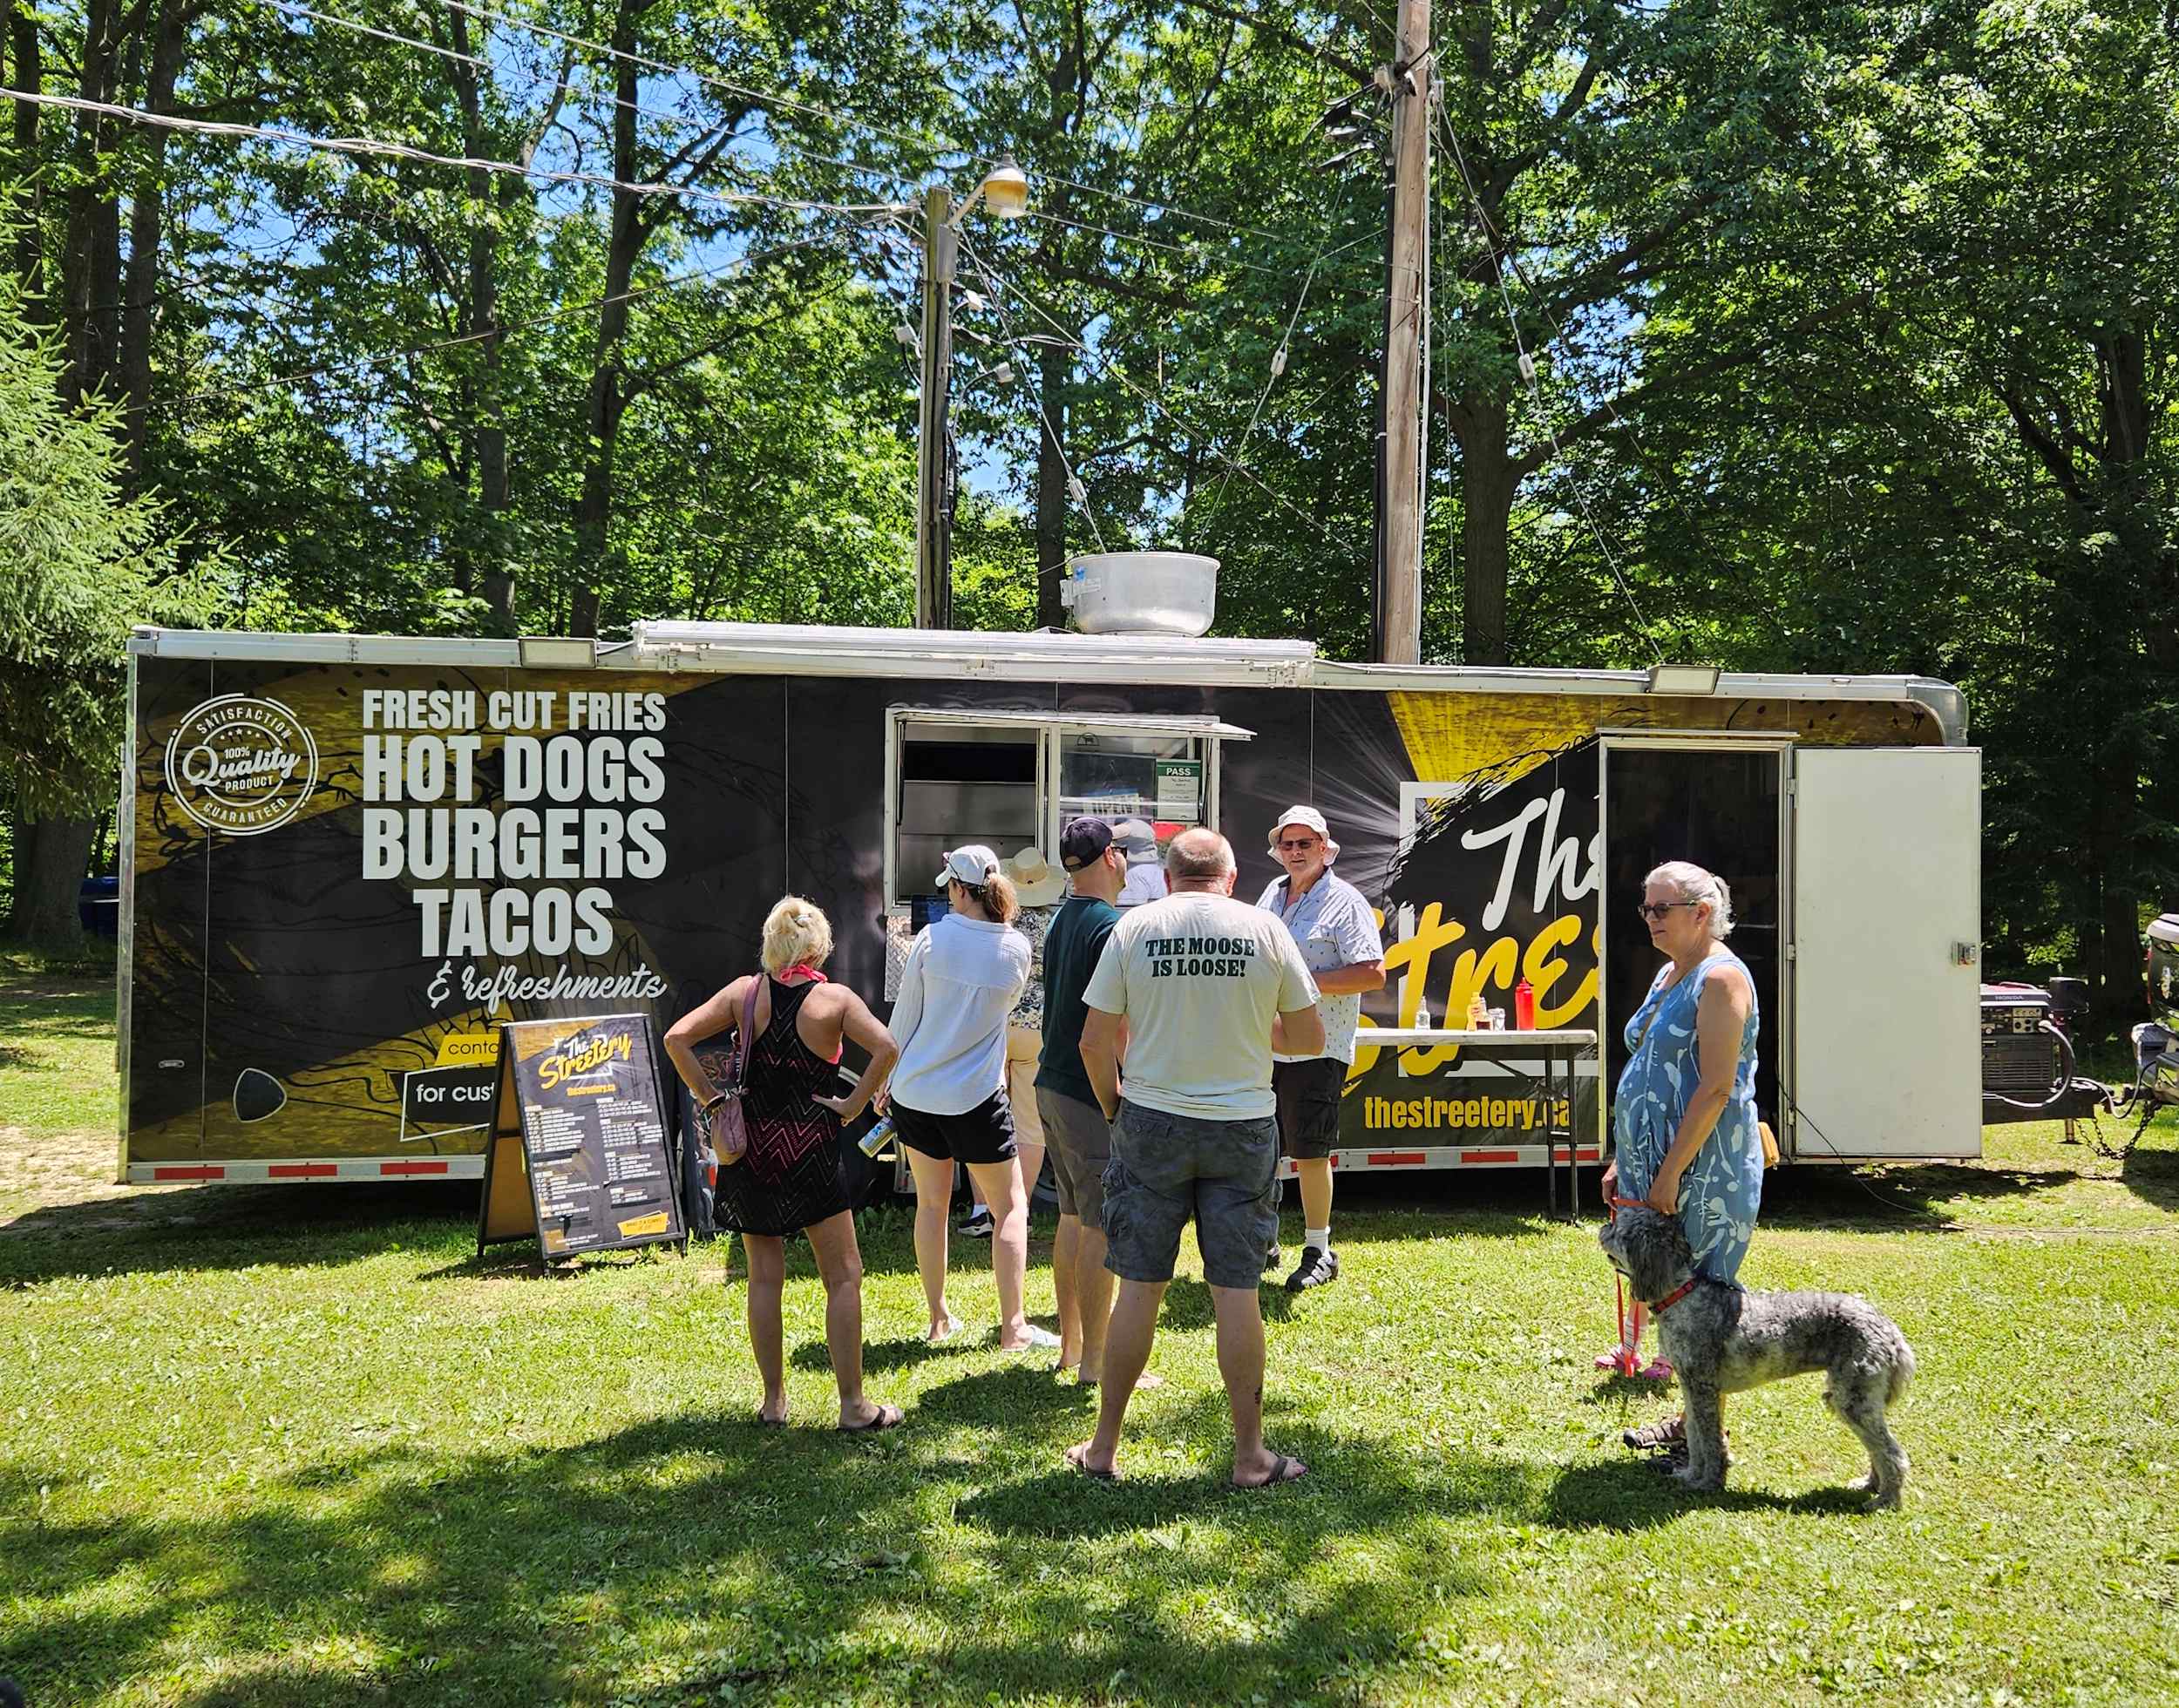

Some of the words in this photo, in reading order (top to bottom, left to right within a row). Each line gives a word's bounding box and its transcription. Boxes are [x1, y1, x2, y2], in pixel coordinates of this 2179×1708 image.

[196, 707, 294, 739] SATISFACTION
[363, 689, 476, 729] FRESH
[489, 691, 557, 730] CUT
[568, 691, 667, 731] FRIES
[182, 745, 301, 787] Quality
[224, 746, 250, 759] 100%
[225, 775, 274, 792] PRODUCT
[363, 735, 482, 802] HOT
[504, 736, 666, 803] DOGS
[1166, 767, 1192, 776] PASS
[203, 797, 288, 824] GUARANTEED
[363, 808, 667, 880] BURGERS
[412, 887, 614, 958] TACOS
[1145, 938, 1185, 957] THE
[1188, 938, 1255, 957] MOOSE
[1151, 959, 1172, 977] IS
[1176, 959, 1246, 977] LOOSE!
[427, 960, 453, 1009] &
[461, 962, 668, 1014] refreshments
[538, 1033, 633, 1090] Streetery
[563, 1036, 590, 1059] The
[416, 1084, 447, 1102] for
[1365, 1096, 1571, 1130] thestreetery.ca
